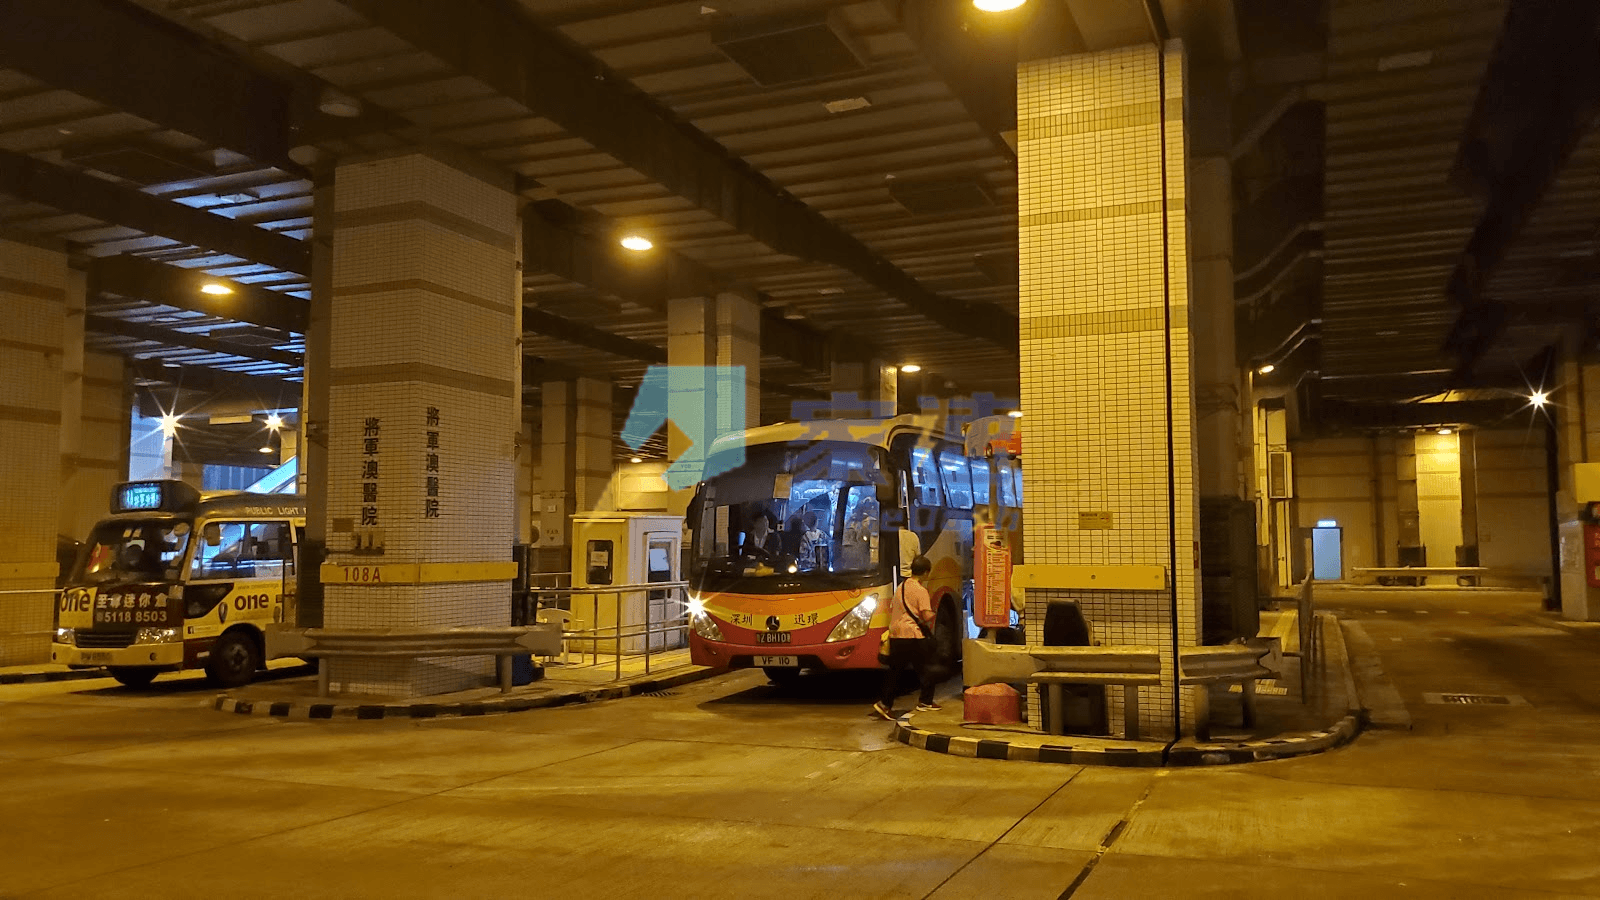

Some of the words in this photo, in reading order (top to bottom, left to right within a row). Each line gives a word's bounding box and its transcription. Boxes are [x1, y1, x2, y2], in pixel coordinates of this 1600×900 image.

[425, 406, 440, 518] 將軍澳醫院
[361, 417, 380, 526] 將軍澳醫院
[245, 507, 273, 515] PUBLIC
[278, 507, 299, 515] LIGHT
[344, 567, 381, 582] 108A
[61, 592, 91, 612] one
[234, 593, 270, 611] one
[104, 611, 132, 623] 5118
[135, 611, 168, 622] 8503
[730, 613, 754, 627] 深圳
[794, 612, 819, 626] 迅環
[761, 656, 774, 666] VF
[778, 656, 790, 666] 110
